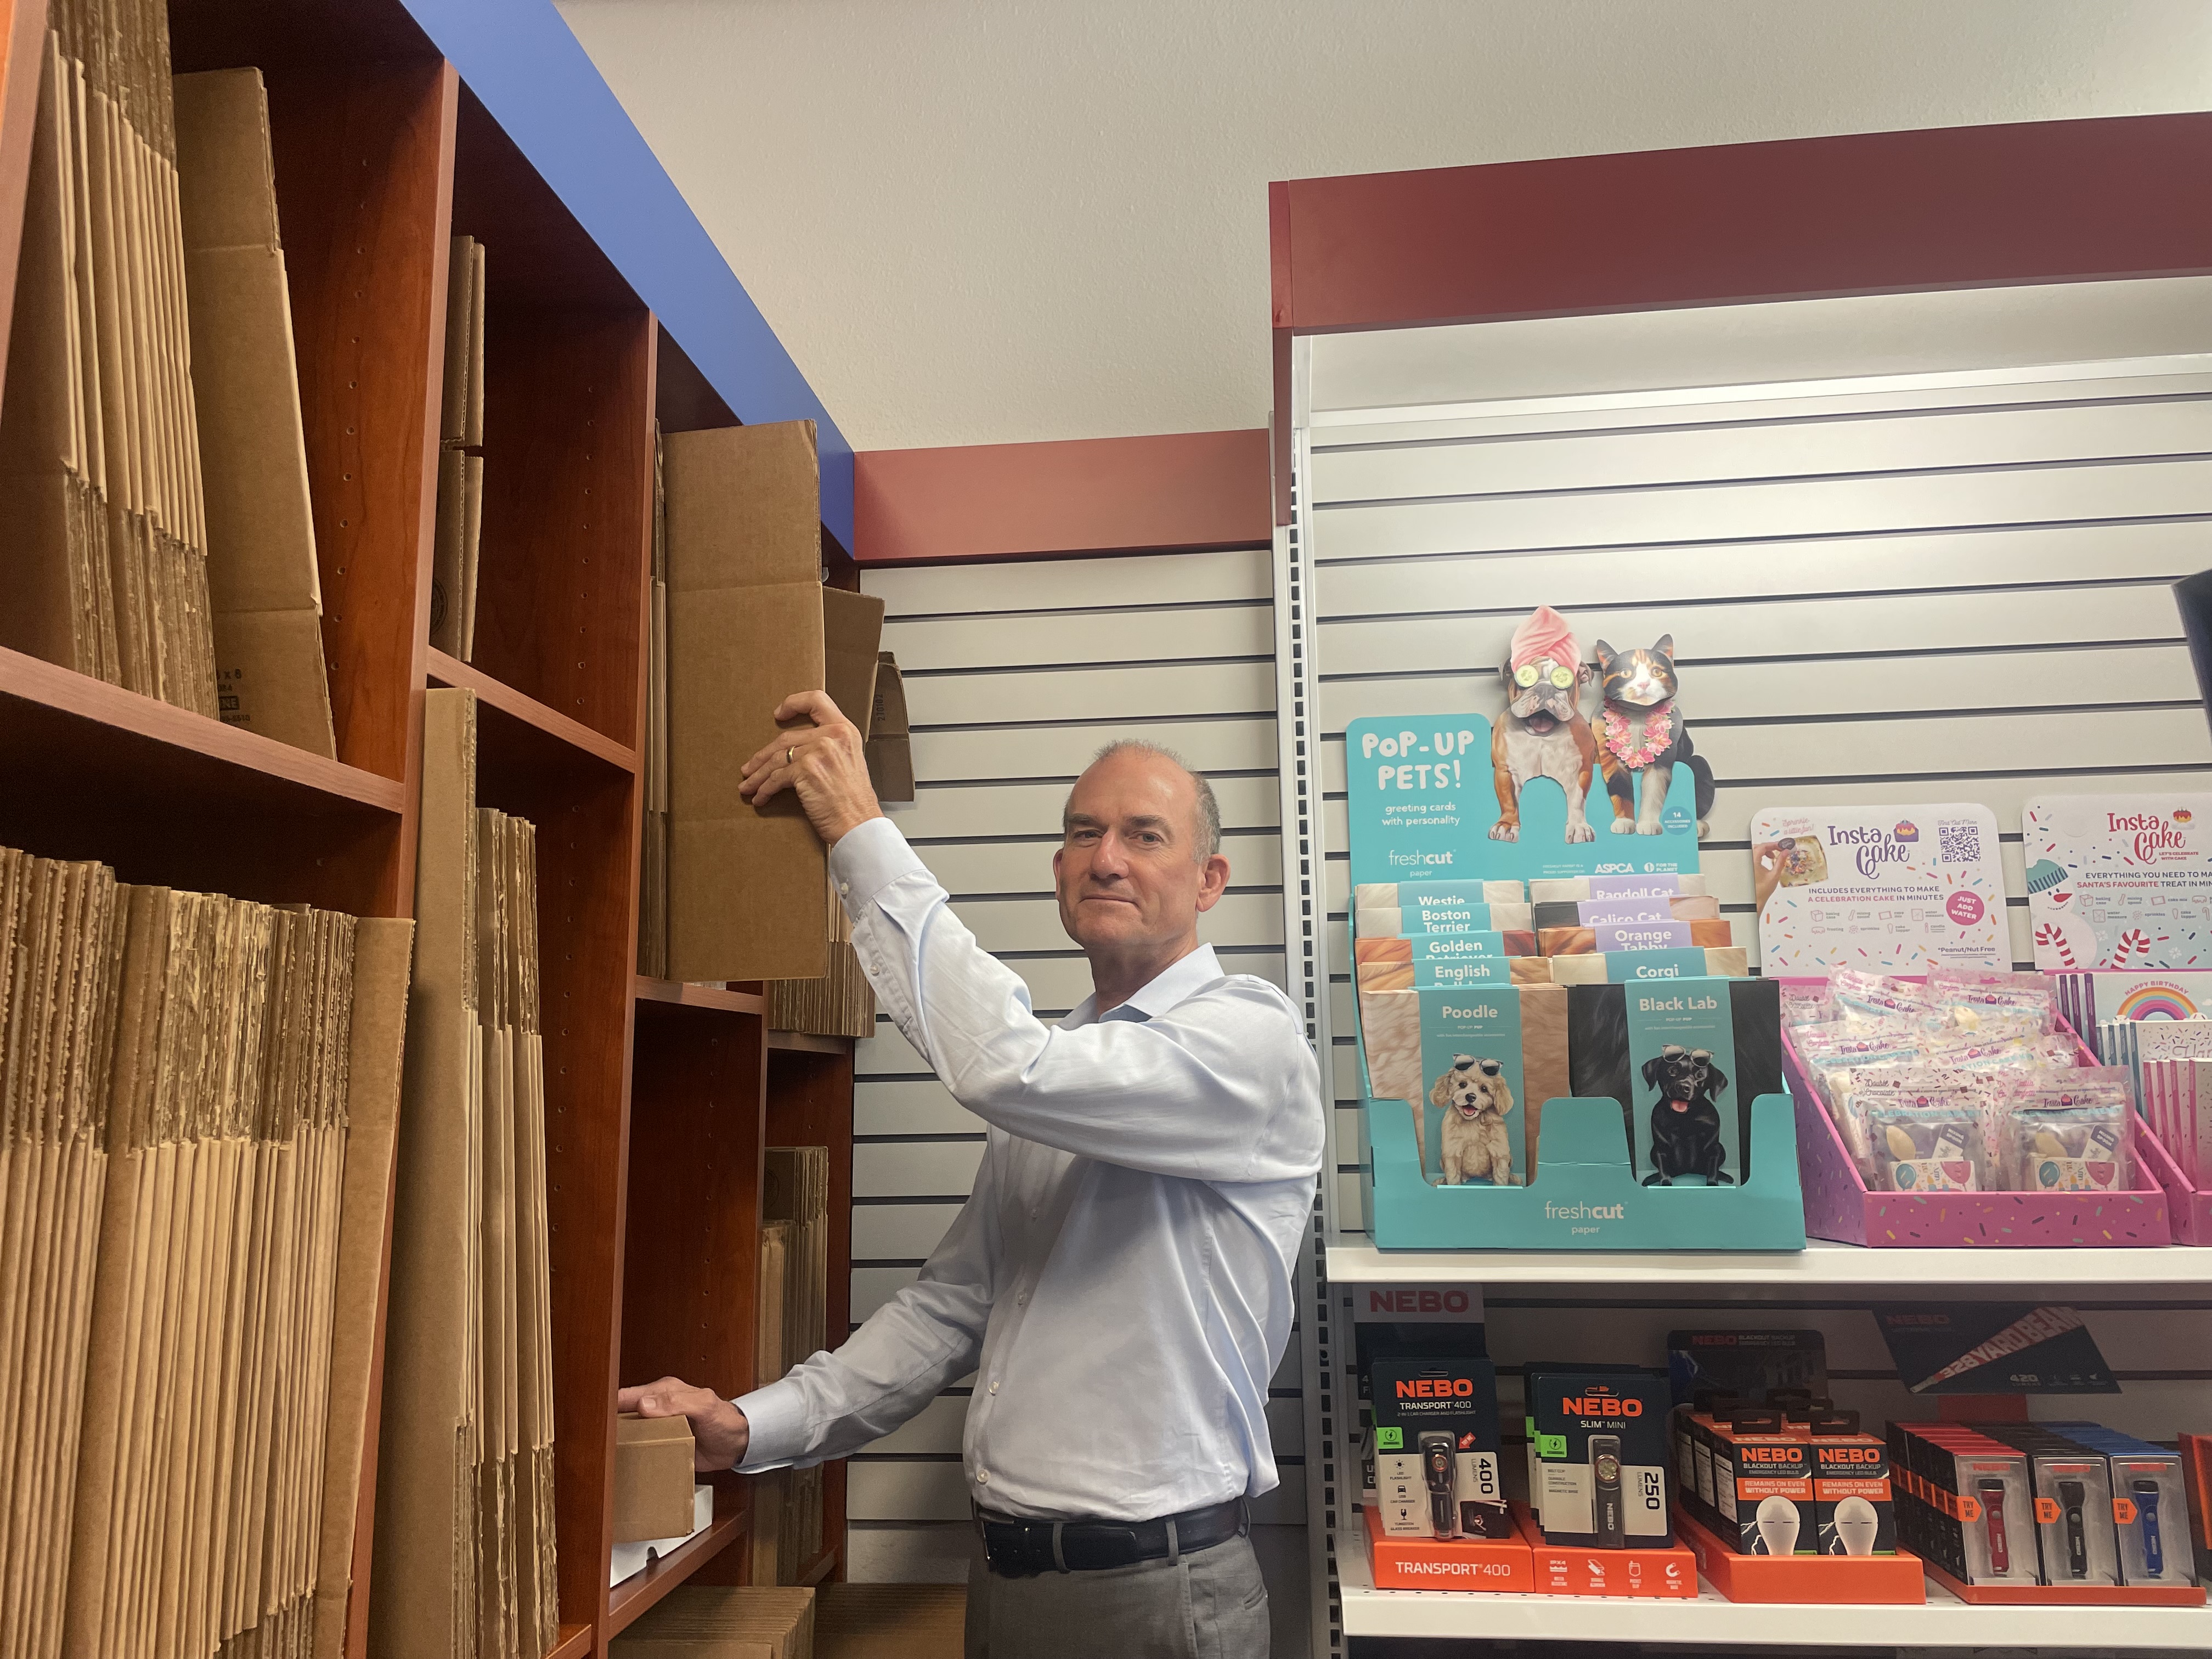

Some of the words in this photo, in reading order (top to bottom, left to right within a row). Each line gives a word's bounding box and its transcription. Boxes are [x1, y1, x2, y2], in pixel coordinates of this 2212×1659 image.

[1378, 759, 1461, 790] PETS!
[1385, 804, 1426, 815] greeting
[1430, 802, 1456, 811] cards
[1382, 816, 1402, 826] with
[1406, 815, 1460, 827] personality
[2107, 812, 2159, 832] Insta
[1827, 826, 1882, 845] Insta
[2134, 821, 2186, 865] Cake
[1389, 849, 1453, 866] freshcut
[1856, 833, 1910, 879] Cake
[1595, 863, 1634, 873] ASPCA
[1651, 888, 1674, 896] Cat
[1418, 895, 1465, 905] Westie
[1957, 896, 1977, 904] JUST
[1422, 910, 1470, 921] Boston
[1951, 909, 1977, 919] WATER
[1424, 921, 1470, 933] Terrier
[1615, 930, 1672, 943] Orange
[1430, 940, 1482, 953] Golden
[1435, 964, 1490, 980] English
[1636, 964, 1679, 978] Corgi
[2124, 981, 2148, 996] HAPPY
[2151, 980, 2189, 995] BIRTHDAY
[1639, 997, 1684, 1011] Black
[1688, 996, 1718, 1010] Lab
[1867, 995, 1884, 1005] Insta
[1896, 1002, 1915, 1013] Cake
[1968, 995, 1984, 1004] Insta
[1997, 996, 2017, 1006] Cake
[1442, 1005, 1498, 1018] Poodle
[1839, 1045, 1857, 1054] Insta
[1869, 1040, 1890, 1051] Cake
[1949, 1053, 1968, 1064] Insta
[1980, 1046, 2001, 1057] Cake
[1865, 1079, 1889, 1087] Double
[1929, 1097, 1951, 1108] Cake
[2043, 1098, 2060, 1108] Insta
[2074, 1094, 2094, 1105] Cake
[1544, 1200, 1624, 1219] freshcut
[1572, 1227, 1600, 1235] paper
[1370, 1290, 1469, 1313] NEBO
[1940, 1354, 1979, 1378] 328
[1970, 1325, 2030, 1363] YARD
[2010, 1374, 2039, 1383] 420
[1396, 1379, 1473, 1398] NEBO
[1400, 1402, 1451, 1410] TRANSPORT
[1562, 1397, 1643, 1417] NEBO
[1741, 1447, 1803, 1463] NEBO
[1818, 1448, 1880, 1463] NEBO
[1479, 1458, 1493, 1494] 400
[1644, 1471, 1660, 1510] 250
[1963, 1500, 1974, 1509] TRY
[2117, 1503, 2128, 1511] TRY
[1395, 1561, 1479, 1575] TRANSPORT
[1483, 1564, 1511, 1576] 400
